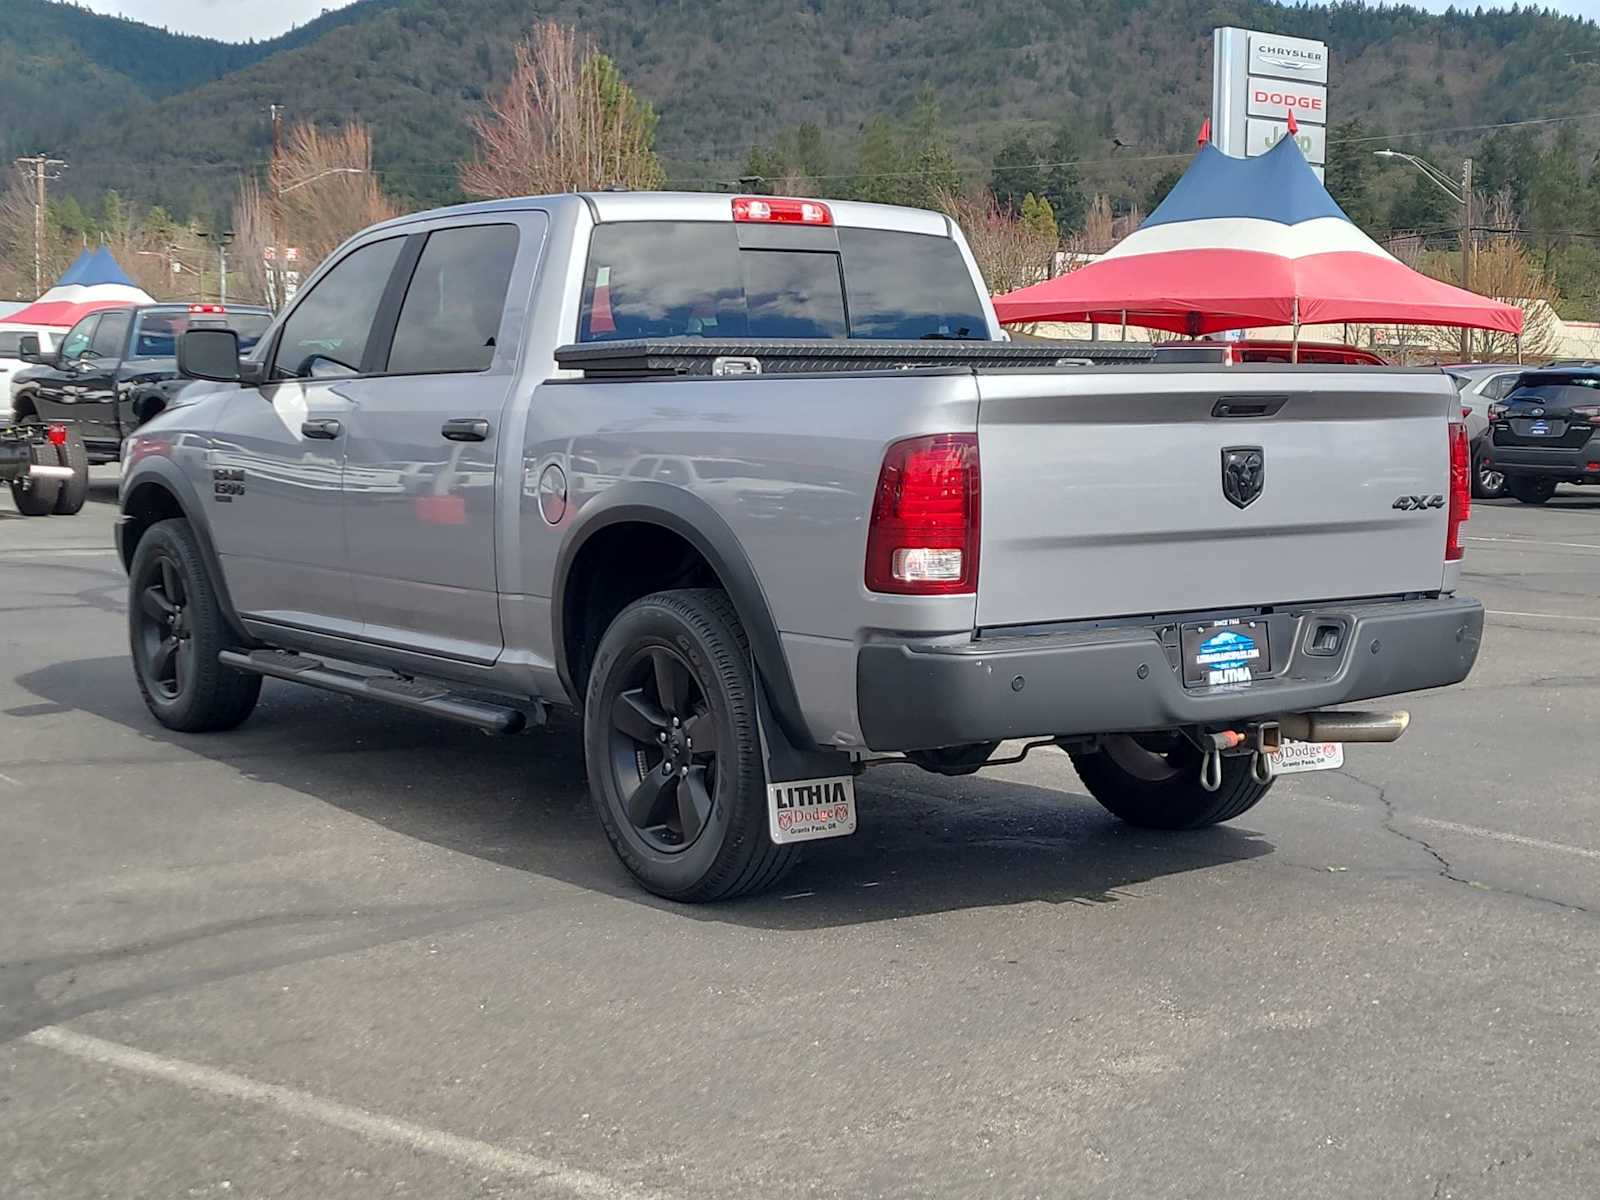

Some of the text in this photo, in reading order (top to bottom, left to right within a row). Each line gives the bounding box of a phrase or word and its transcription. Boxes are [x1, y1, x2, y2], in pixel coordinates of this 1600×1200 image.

[1258, 45, 1322, 60] CHRYSLER
[1255, 91, 1322, 110] DODGE
[1265, 126, 1312, 153] Jp
[1285, 744, 1321, 758] Dodge
[776, 783, 847, 809] LITHIA
[794, 807, 834, 823] Dodge
[790, 826, 810, 834] Grants
